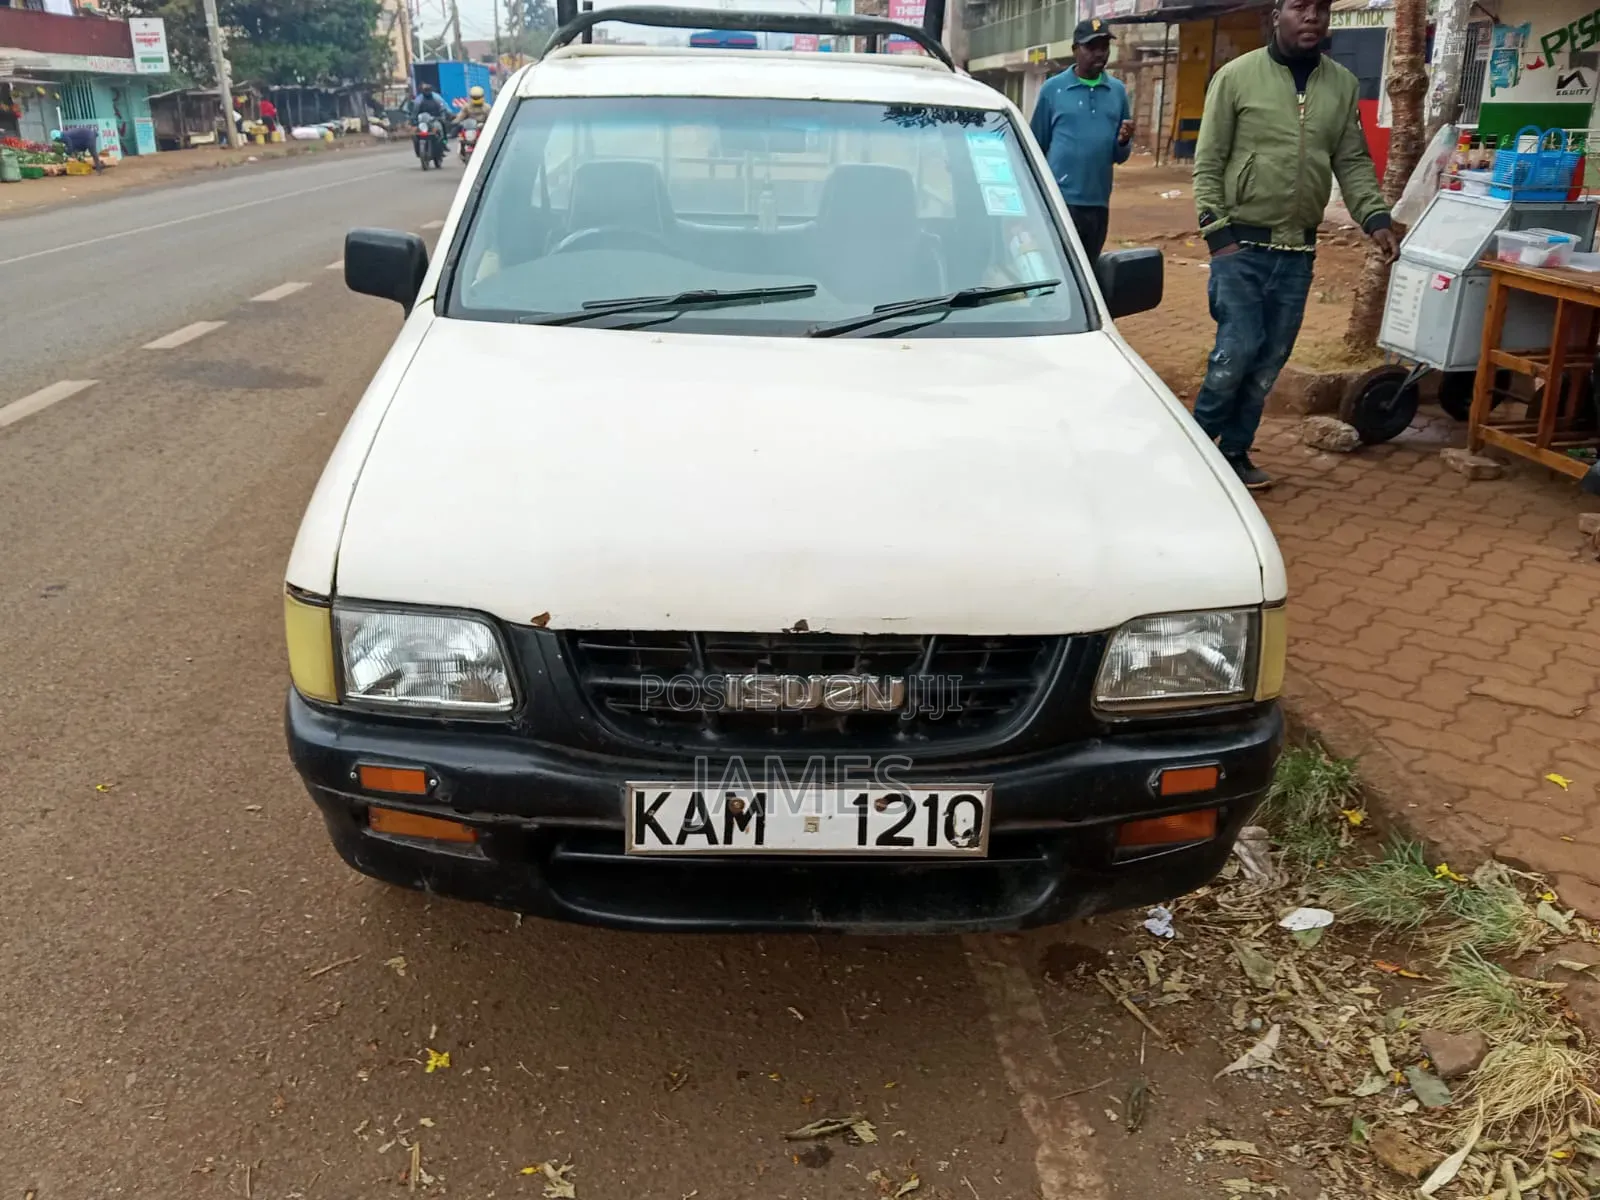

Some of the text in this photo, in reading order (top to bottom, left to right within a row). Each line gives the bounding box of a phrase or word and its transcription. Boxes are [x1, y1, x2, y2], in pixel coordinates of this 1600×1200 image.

[1331, 10, 1351, 26] ESH
[724, 674, 905, 710] ISUZU
[634, 791, 767, 845] KAM
